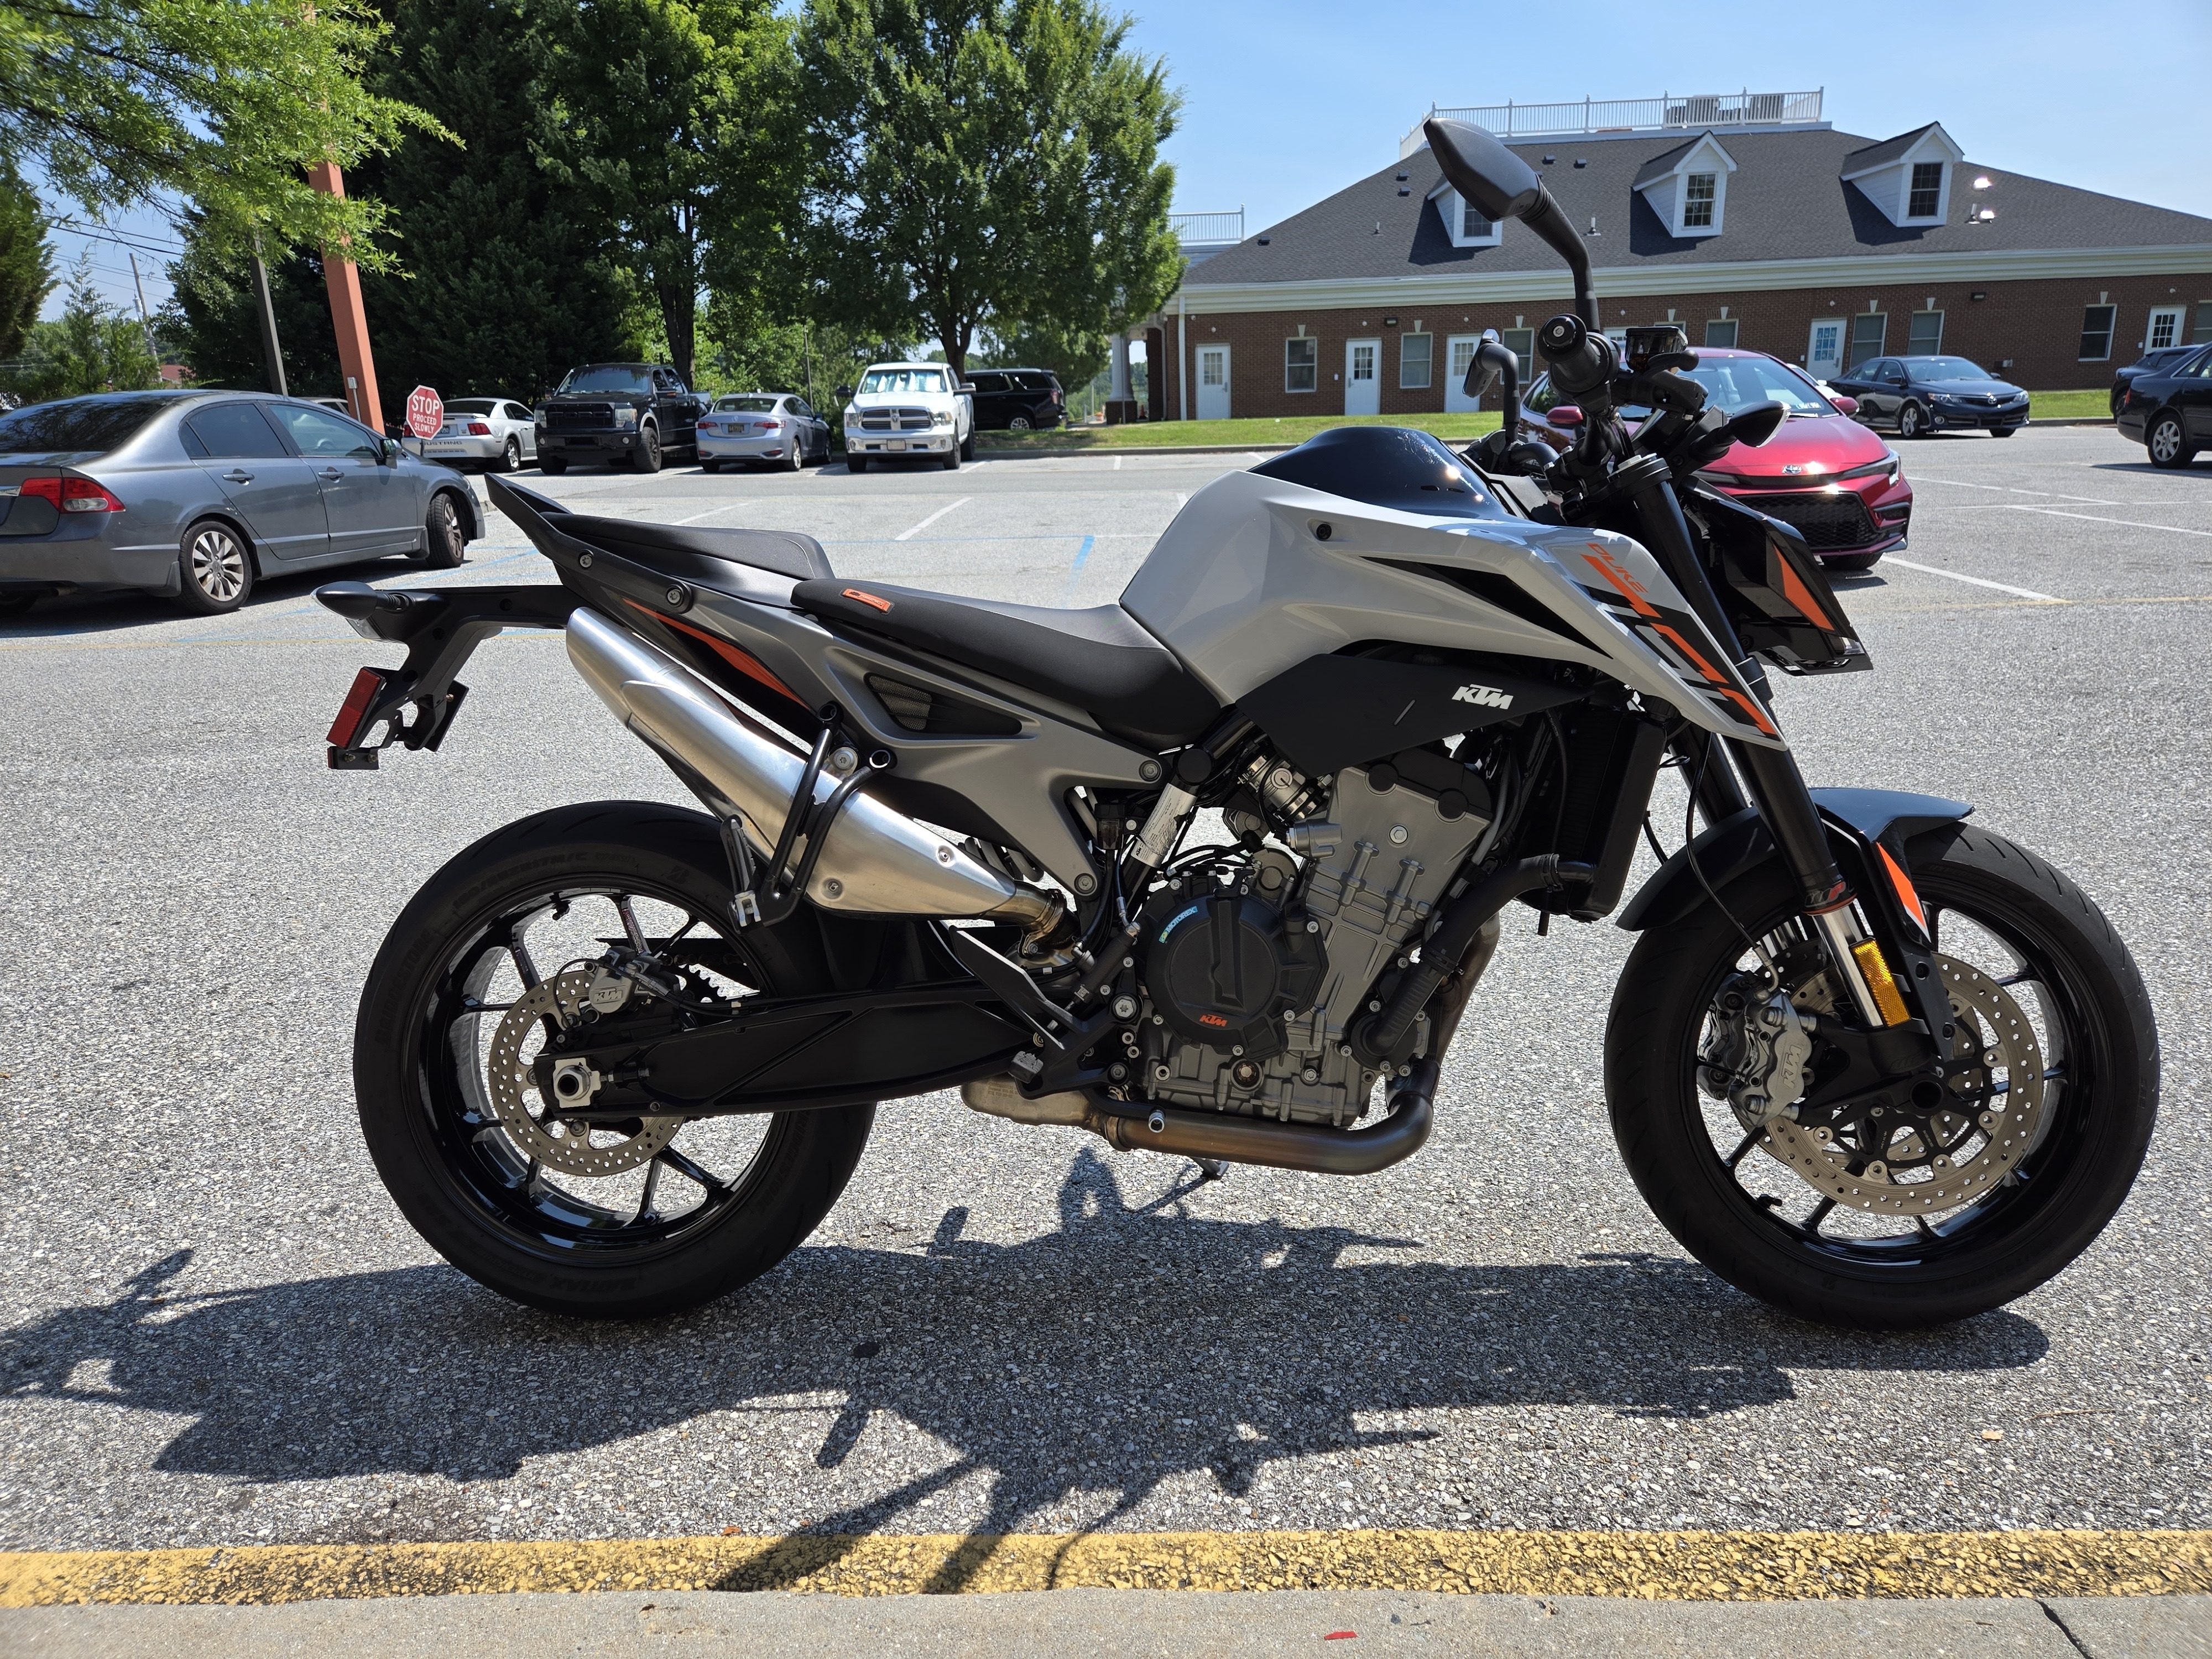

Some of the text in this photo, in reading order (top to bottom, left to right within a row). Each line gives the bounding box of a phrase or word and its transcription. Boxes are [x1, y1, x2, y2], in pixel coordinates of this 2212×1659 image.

[411, 394, 440, 415] STOP
[413, 413, 436, 426] PROCEED
[414, 422, 435, 434] SLOWLY
[1586, 542, 1648, 593] DUKE
[1452, 684, 1514, 709] KTM
[1166, 907, 1196, 932] MOTOREX
[375, 928, 434, 1047] BRIDGESTONE
[594, 988, 623, 1001] KTM
[1199, 1014, 1228, 1027] KTM
[1781, 1045, 1802, 1089] KTM
